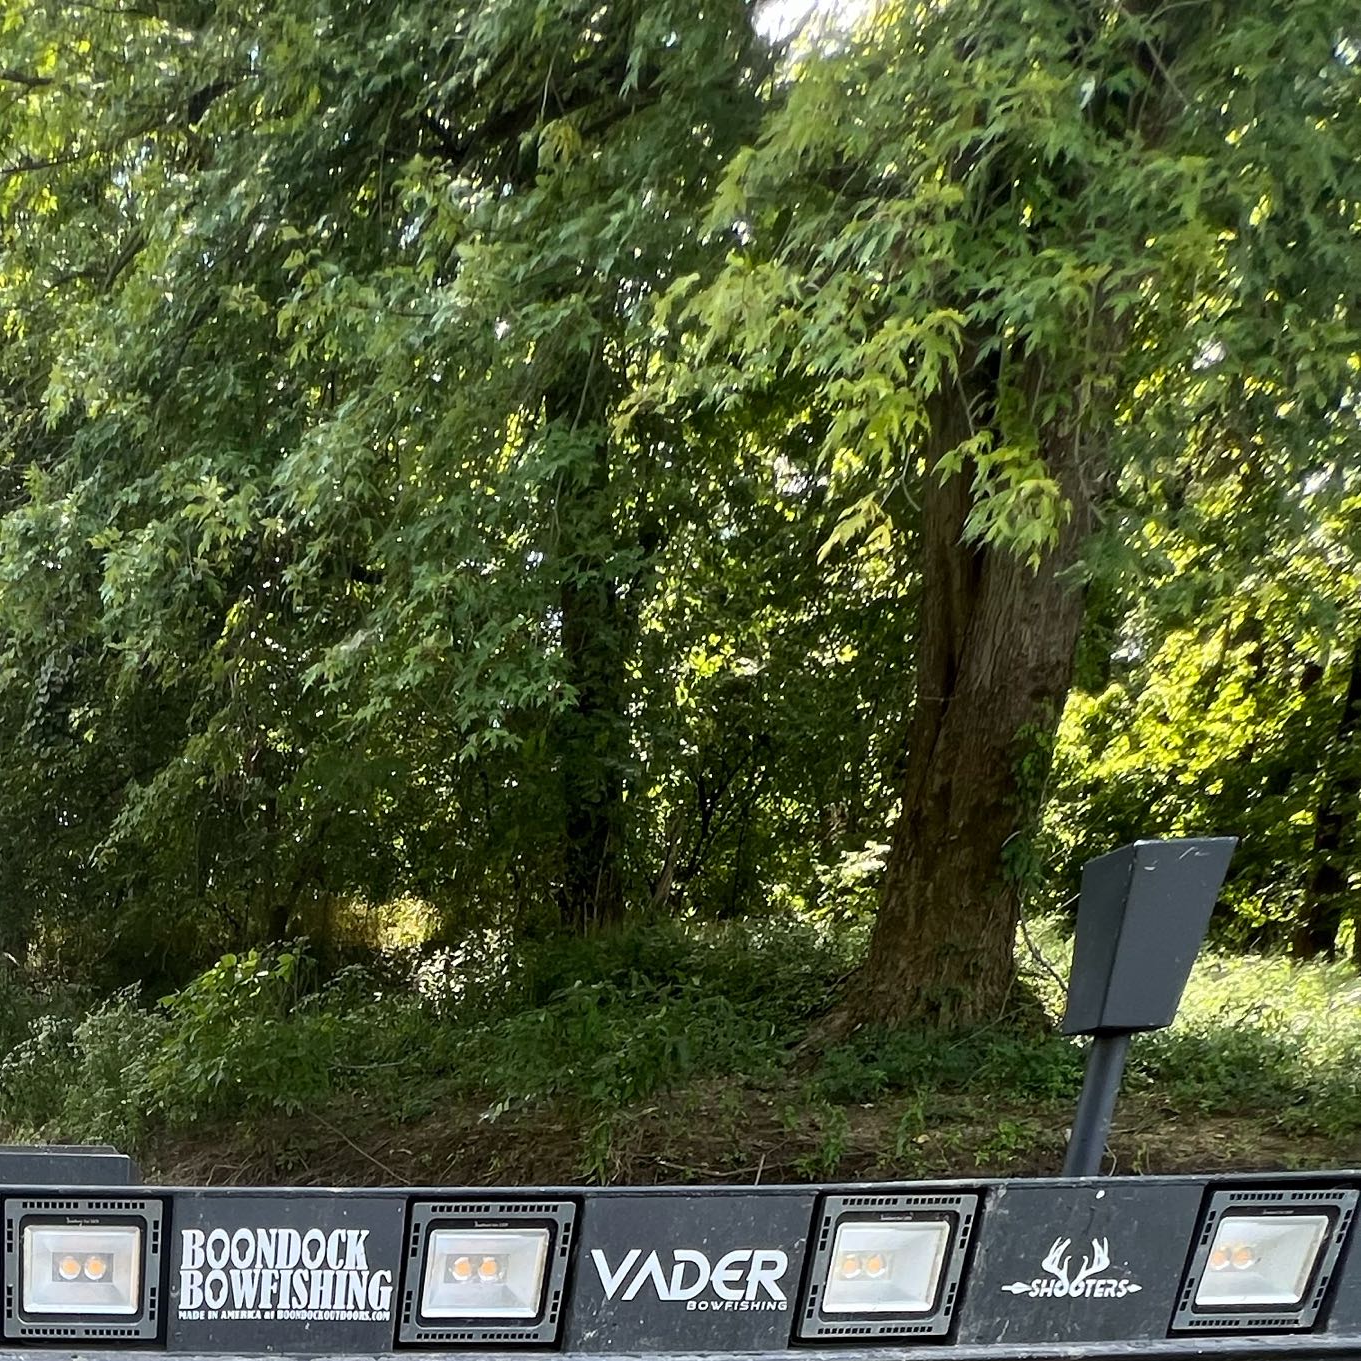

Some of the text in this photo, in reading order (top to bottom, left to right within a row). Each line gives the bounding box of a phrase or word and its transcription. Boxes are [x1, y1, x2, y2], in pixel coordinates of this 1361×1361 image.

[180, 1228, 370, 1270] BOONDOCK
[178, 1268, 394, 1310] BOWFISHING
[591, 1249, 789, 1301] VADER
[1028, 1278, 1130, 1298] SHOOTERS
[178, 1310, 205, 1320] MADE
[207, 1310, 218, 1320] IN
[220, 1310, 262, 1320] AMERICA
[276, 1310, 391, 1321] BOONDOCKOUTDOORS.COM
[686, 1301, 788, 1311] BOWFISHING
